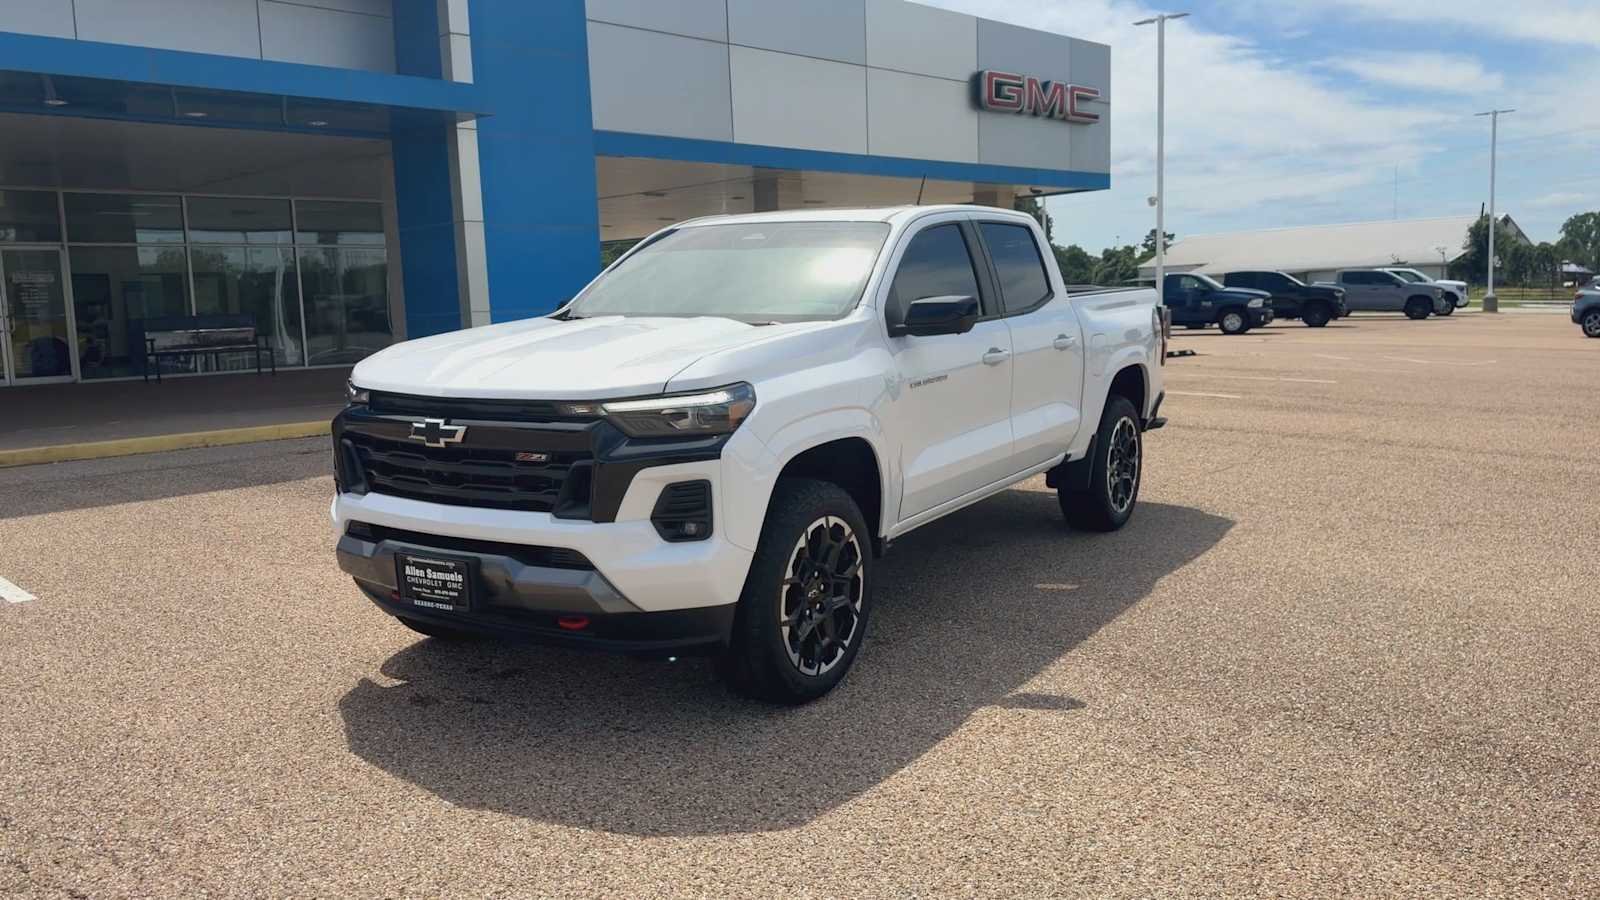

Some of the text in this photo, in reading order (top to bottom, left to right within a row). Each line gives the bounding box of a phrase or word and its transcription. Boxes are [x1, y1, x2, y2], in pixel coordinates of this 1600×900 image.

[982, 70, 1100, 124] GMC
[405, 565, 463, 582] Allen Samuels
[406, 576, 463, 590] CHEVROLET GMC
